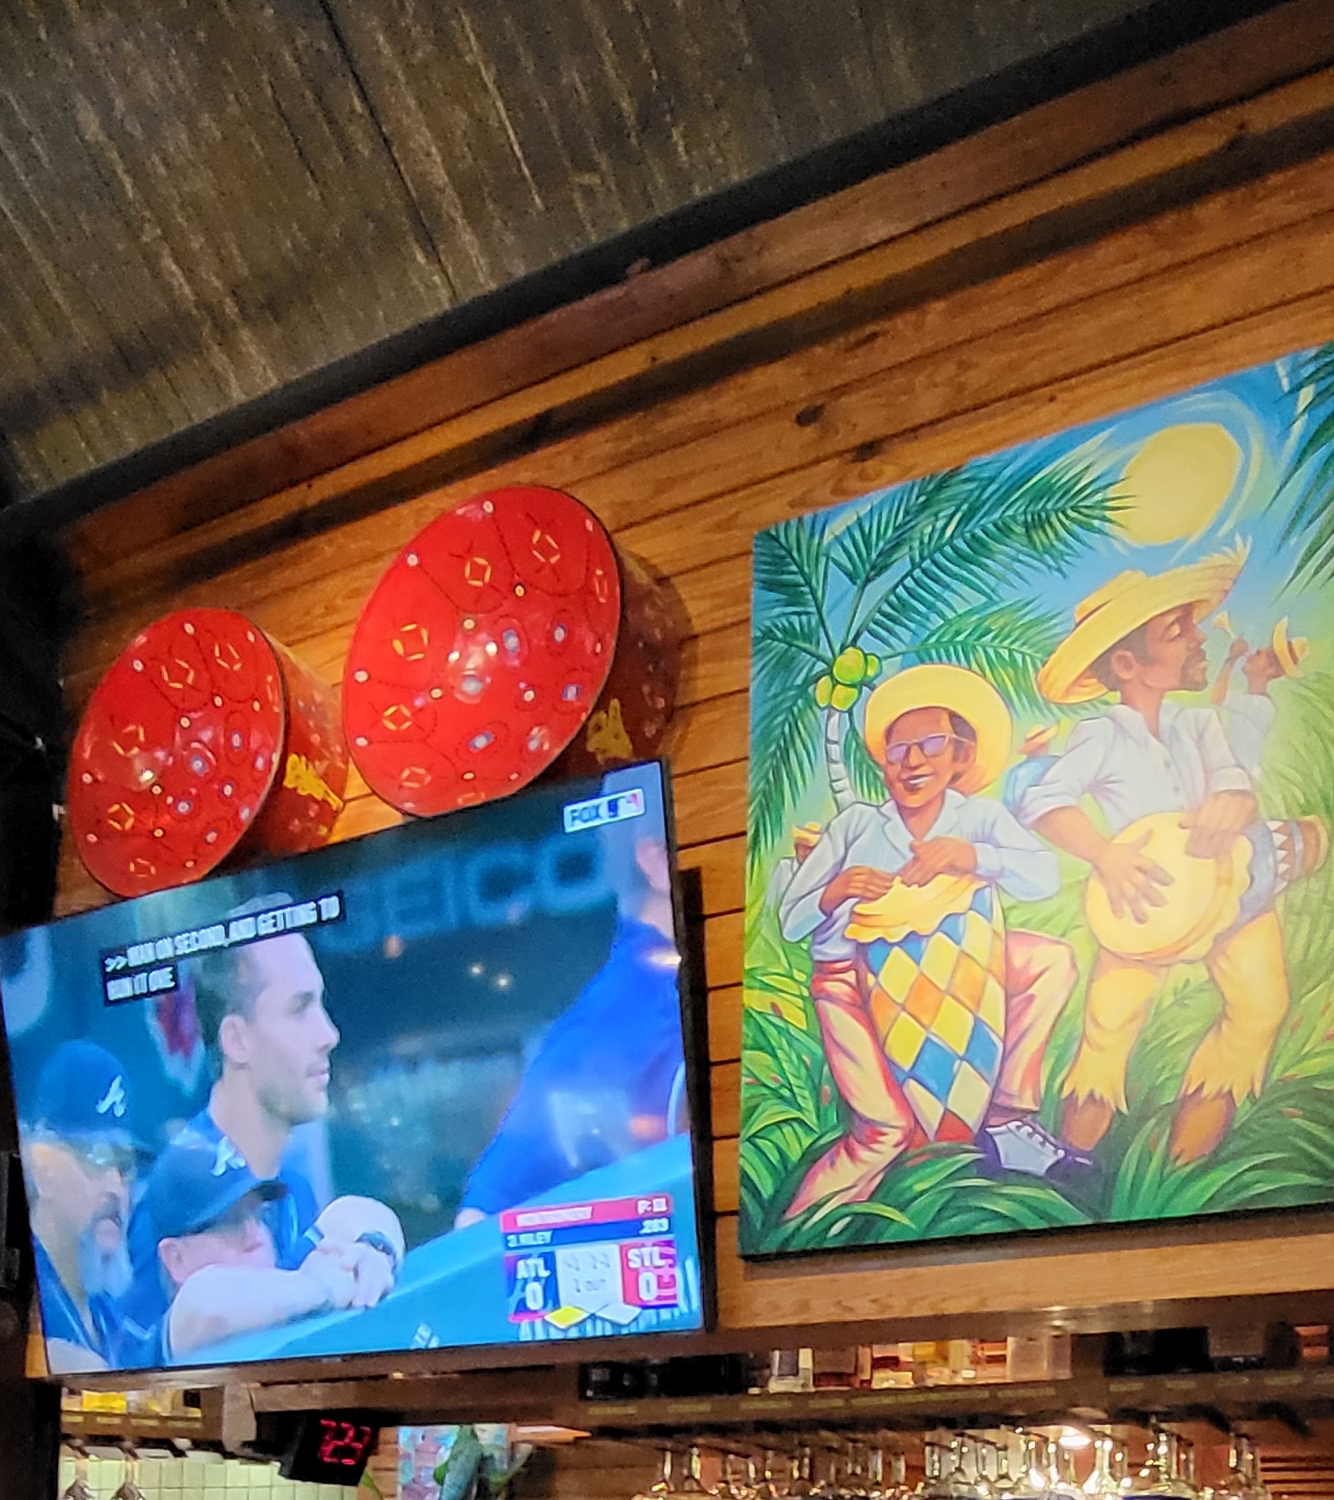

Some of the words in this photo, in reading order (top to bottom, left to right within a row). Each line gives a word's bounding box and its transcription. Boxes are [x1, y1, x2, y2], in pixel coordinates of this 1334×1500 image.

[517, 1257, 551, 1279] ATL
[627, 1246, 665, 1268] STL
[525, 1281, 544, 1311] 0
[638, 1272, 658, 1301] 0
